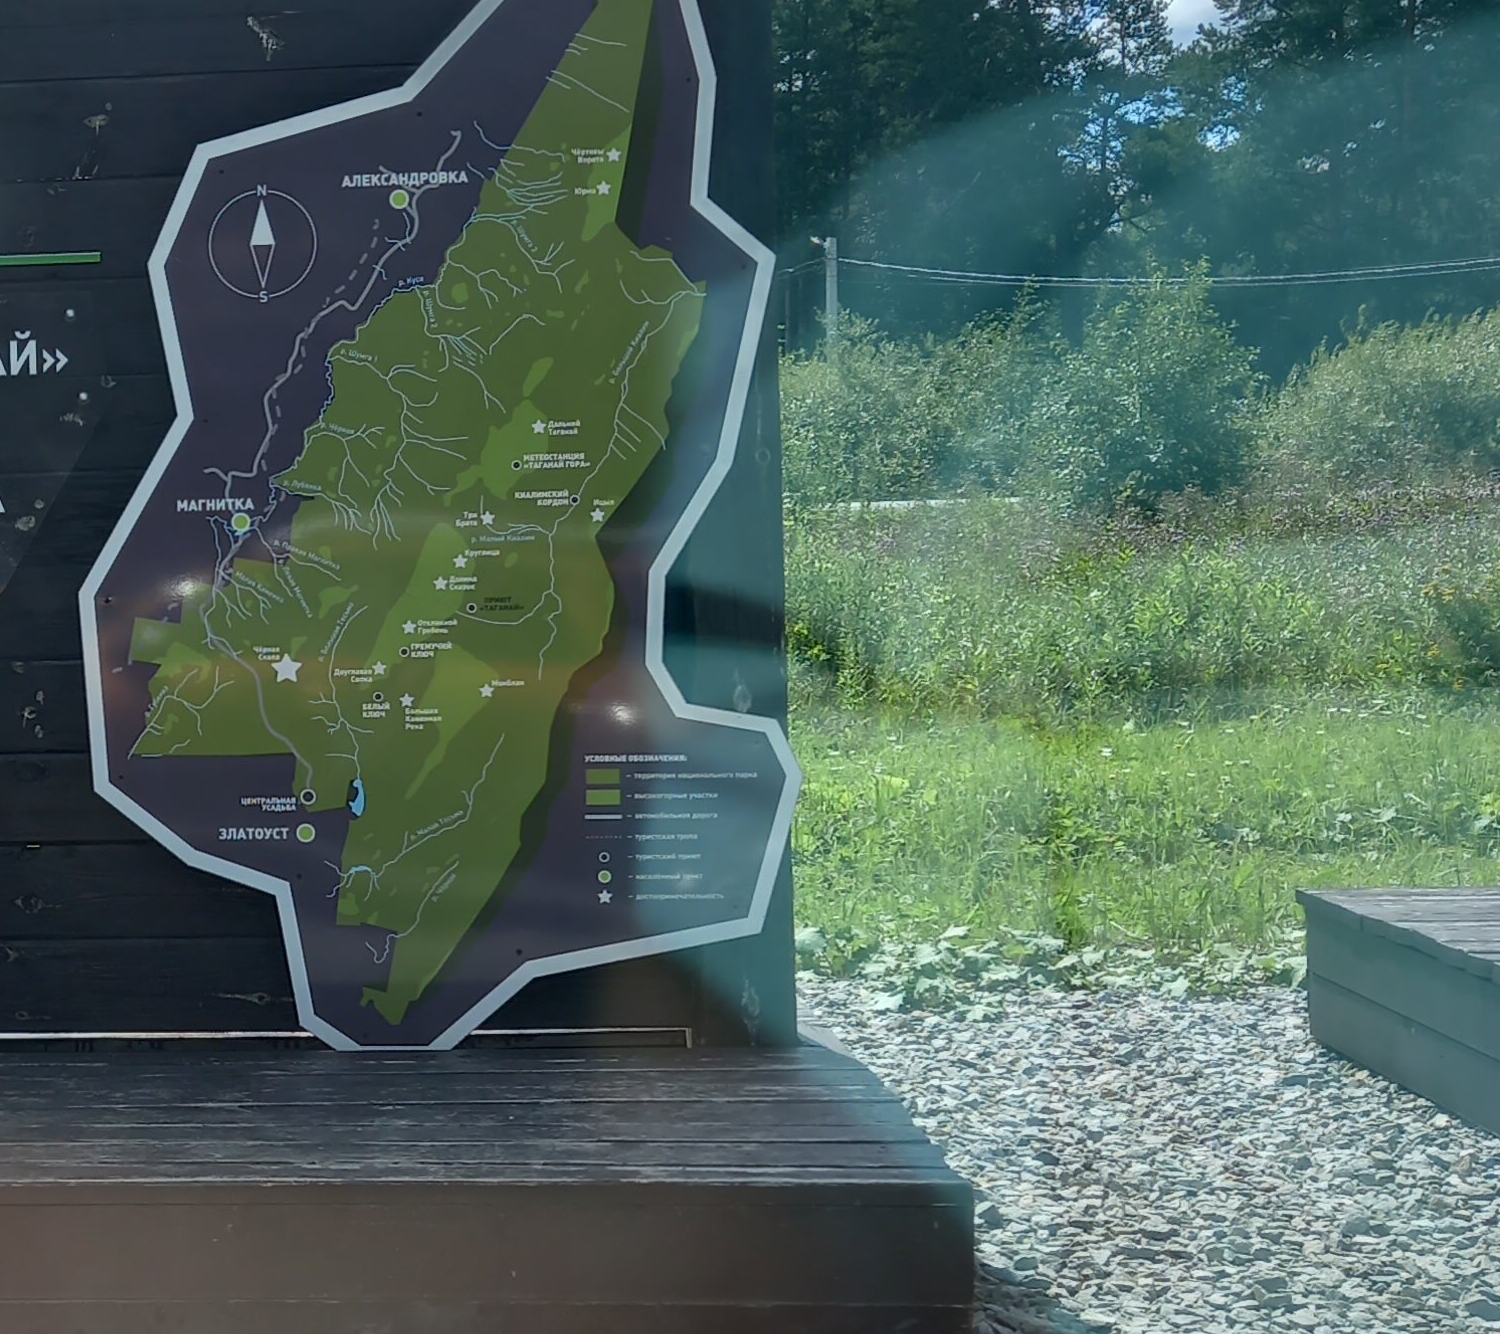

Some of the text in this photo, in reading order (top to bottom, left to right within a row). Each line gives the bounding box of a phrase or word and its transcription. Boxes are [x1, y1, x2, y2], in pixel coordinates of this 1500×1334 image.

[341, 171, 468, 187] АЛЕКСАНДРОВКА
[257, 185, 267, 196] N
[259, 291, 268, 302] S
[176, 498, 255, 513] МАГНИТКА
[218, 828, 290, 841] ЗЛАТОУСТ
